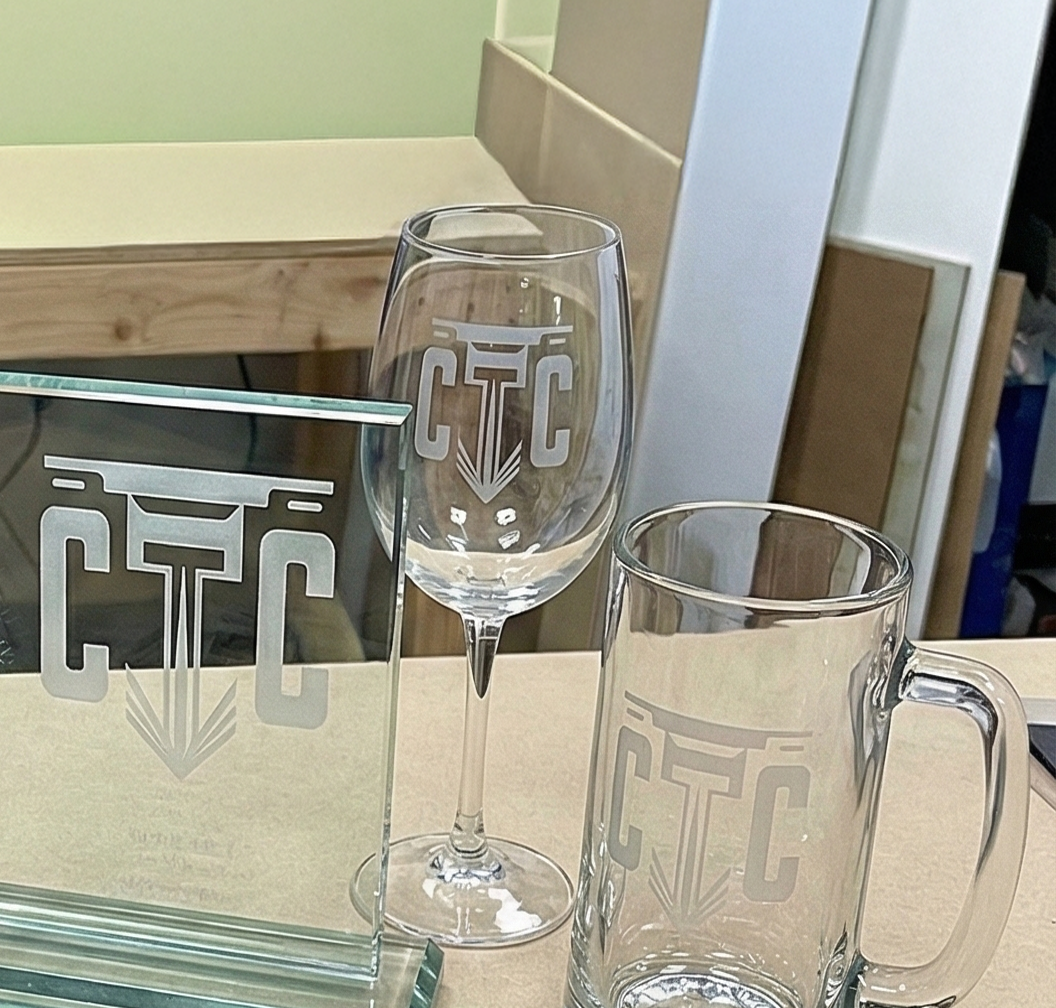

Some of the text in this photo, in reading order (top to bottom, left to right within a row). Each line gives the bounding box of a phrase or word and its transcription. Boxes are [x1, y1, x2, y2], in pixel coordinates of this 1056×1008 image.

[415, 317, 574, 503] CTC
[40, 455, 336, 780] CTC
[608, 690, 813, 929] CTC
